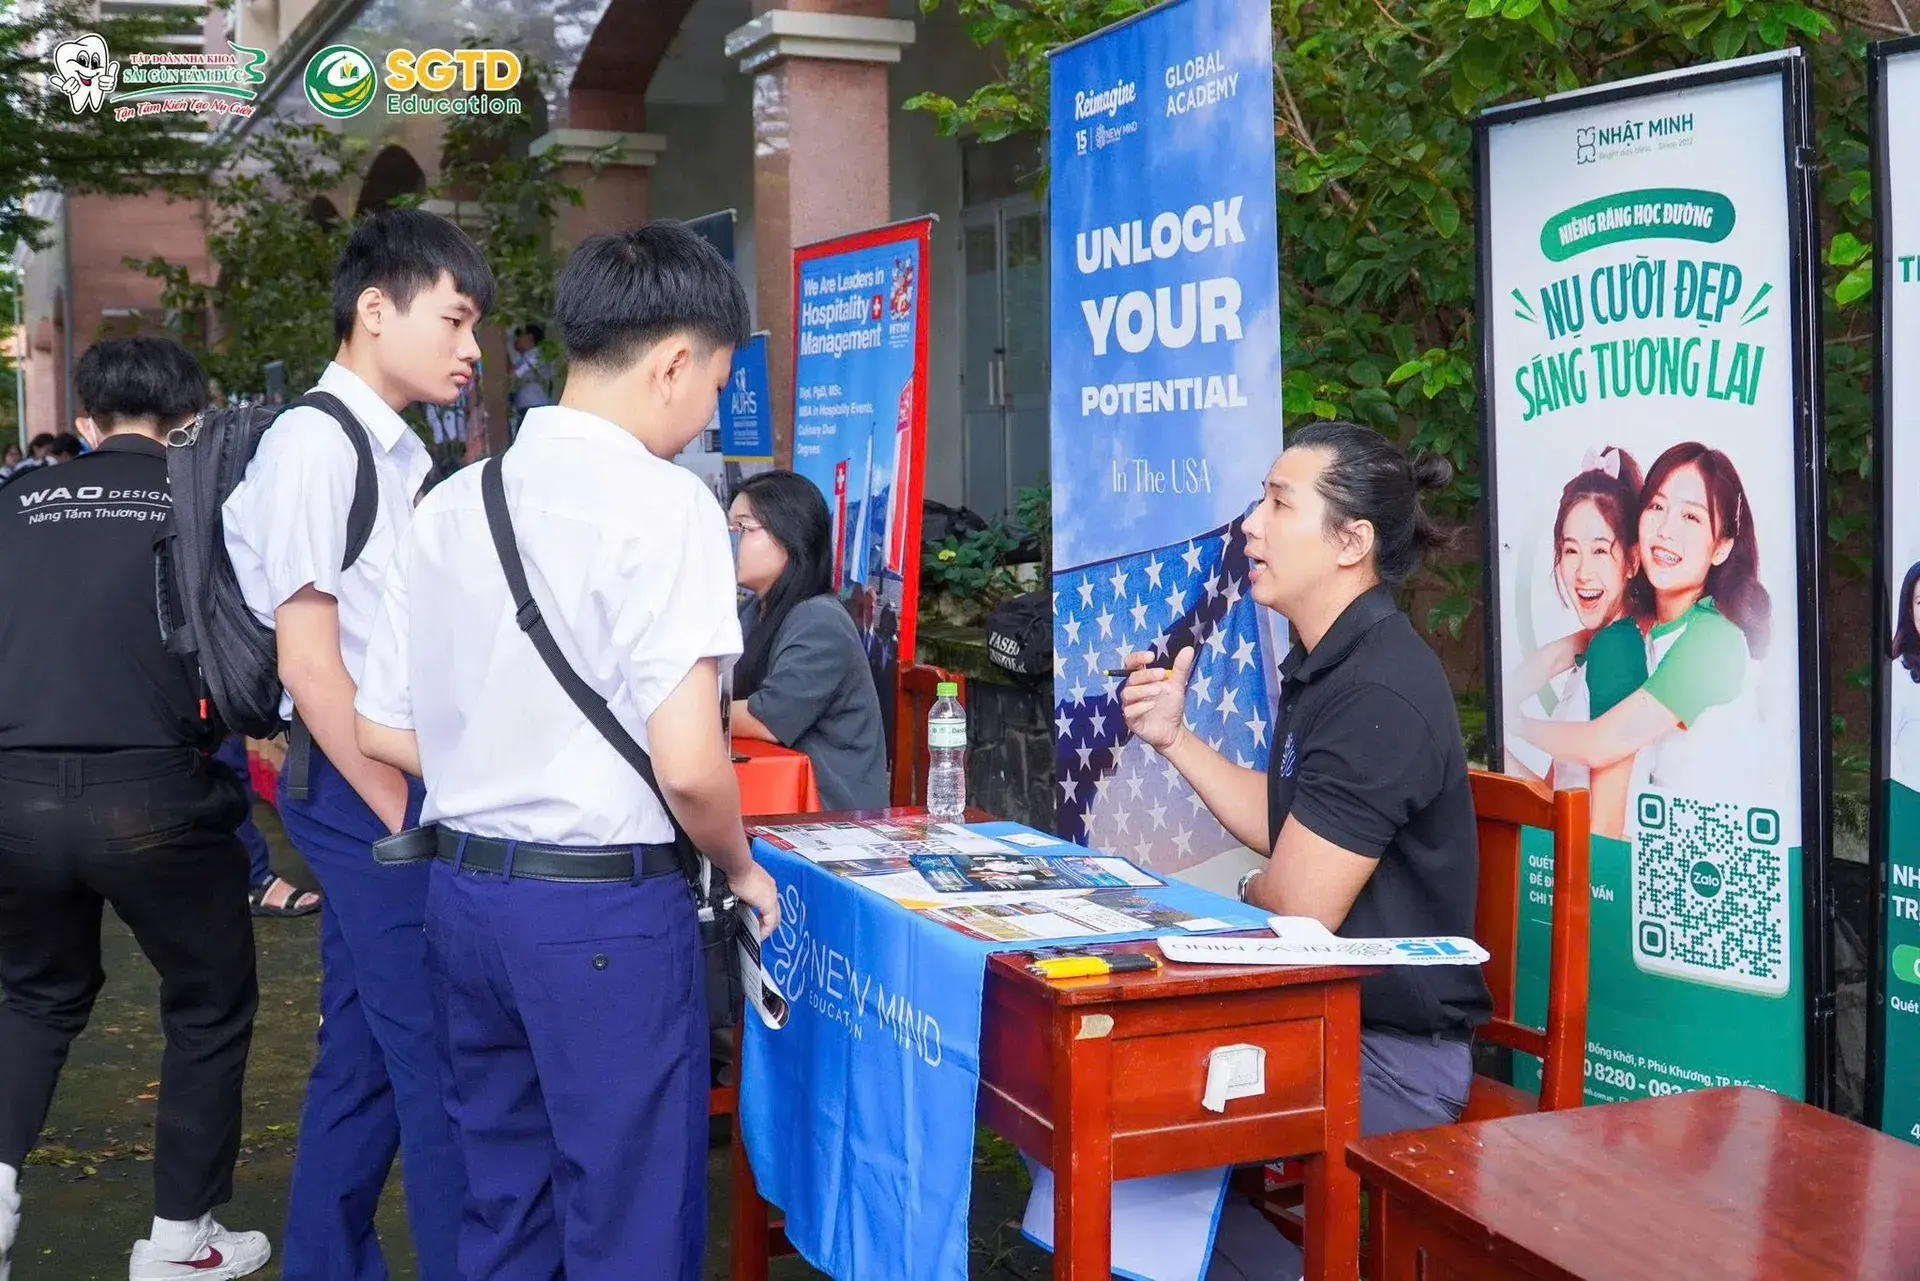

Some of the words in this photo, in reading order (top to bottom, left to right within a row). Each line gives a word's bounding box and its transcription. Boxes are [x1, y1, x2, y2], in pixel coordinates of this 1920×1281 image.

[1165, 49, 1225, 89] GLOBAL
[1075, 79, 1137, 121] Reimagine
[1166, 72, 1239, 118] ACADEMY
[1076, 129, 1087, 151] 15
[1599, 119, 1644, 147] NHẬT
[1648, 113, 1694, 138] MINH
[1076, 195, 1246, 274] UNLOCK
[1597, 204, 1632, 232] RĂNG
[1634, 203, 1661, 227] HỌC
[804, 278, 819, 297] We
[820, 275, 836, 295] Are
[837, 270, 874, 292] Leaders
[874, 267, 885, 286] in
[1540, 274, 1585, 341] NỤ
[1590, 255, 1667, 325] CƯỜI
[1673, 259, 1743, 328] ĐẸP
[802, 294, 870, 330] Hospitality
[1081, 277, 1243, 356] YOUR
[800, 323, 882, 359] Management
[1081, 374, 1248, 417] POTENTIAL
[1515, 347, 1587, 422] SÁNG
[1590, 337, 1702, 399] TƯƠNG
[1706, 339, 1766, 406] LAI
[1113, 460, 1127, 494] In
[1133, 459, 1165, 494] The
[1171, 457, 1212, 494] USA
[20, 487, 104, 507] WAO
[29, 510, 61, 525] Nâng
[94, 508, 147, 521] Thương
[1591, 884, 1614, 902] VẤN
[1692, 871, 1722, 889] Zalo
[1529, 891, 1547, 905] CHI
[811, 938, 871, 1016] NEW
[877, 983, 942, 1067] MIND
[1891, 996, 1920, 1014] Quét
[1595, 1062, 1636, 1091] 8280
[1648, 1059, 1668, 1074] Phú
